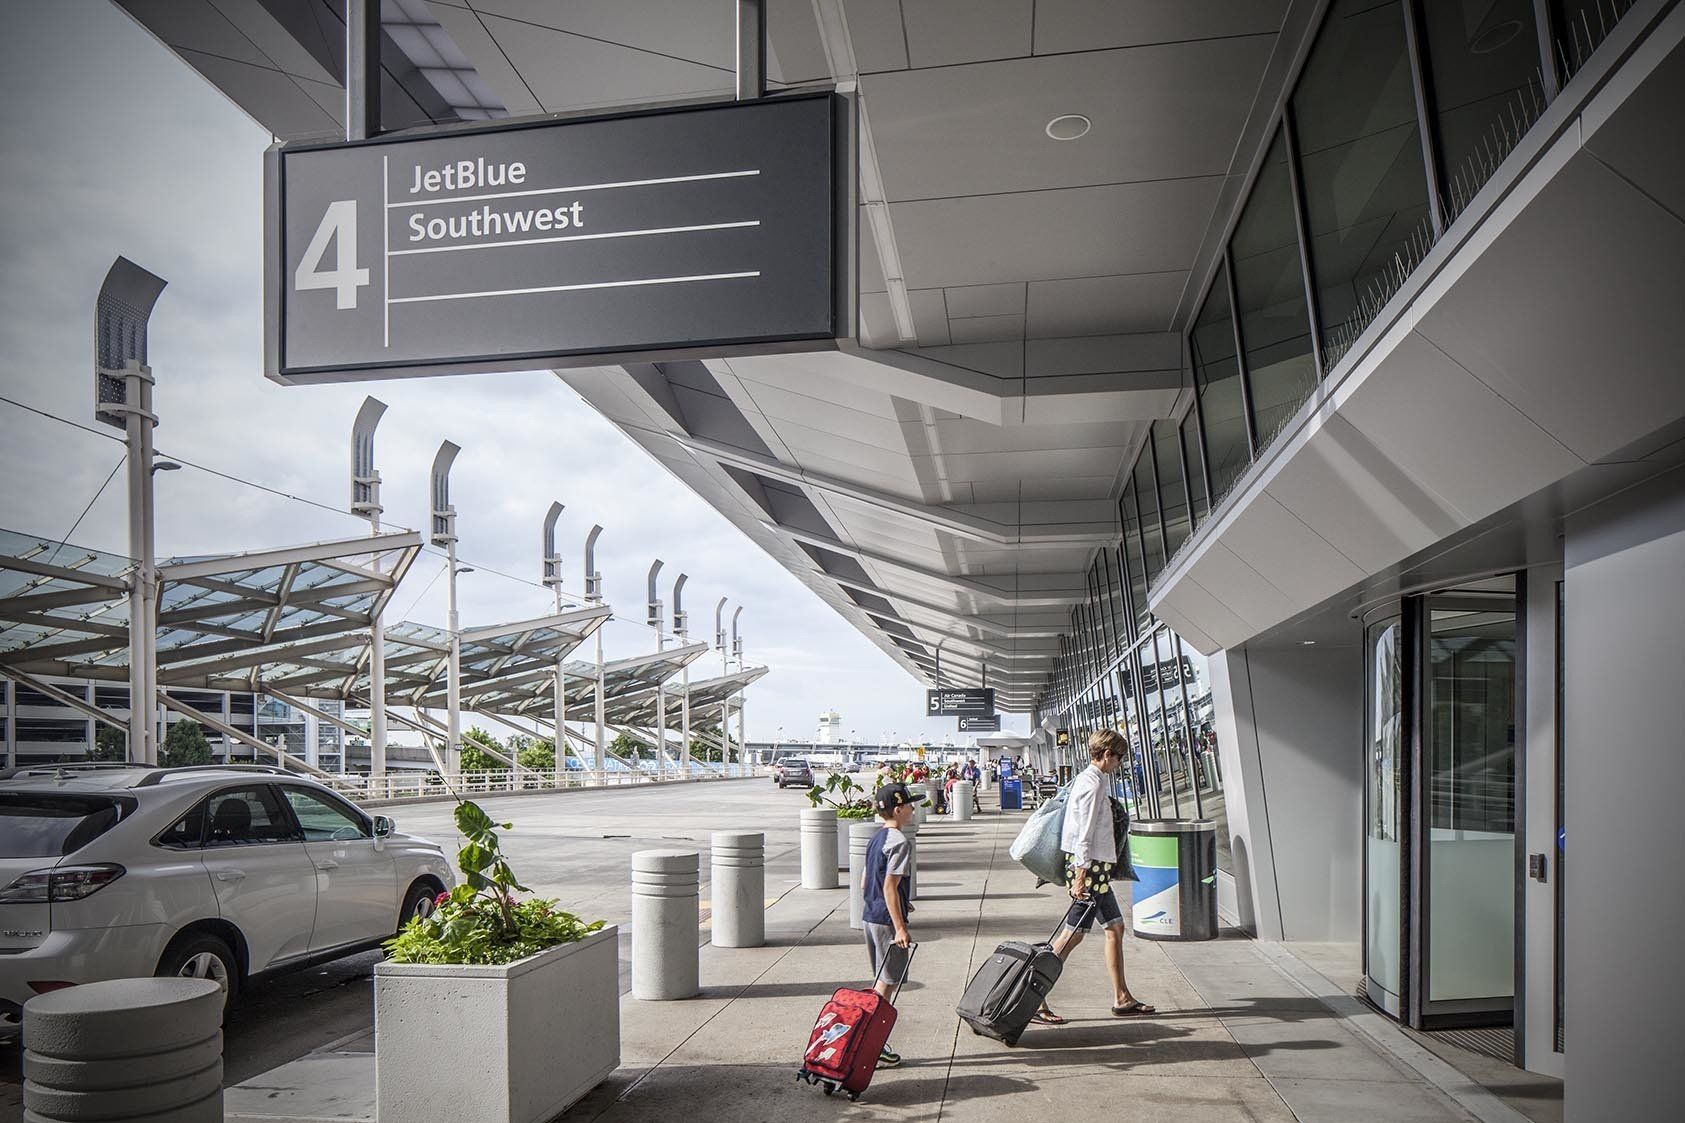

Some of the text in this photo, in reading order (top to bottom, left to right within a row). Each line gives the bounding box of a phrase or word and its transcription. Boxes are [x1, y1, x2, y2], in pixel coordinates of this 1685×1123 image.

[409, 158, 526, 193] JetBlue
[408, 201, 584, 242] Southwest
[294, 200, 370, 309] 4
[930, 697, 940, 710] 5
[960, 719, 967, 729] 6
